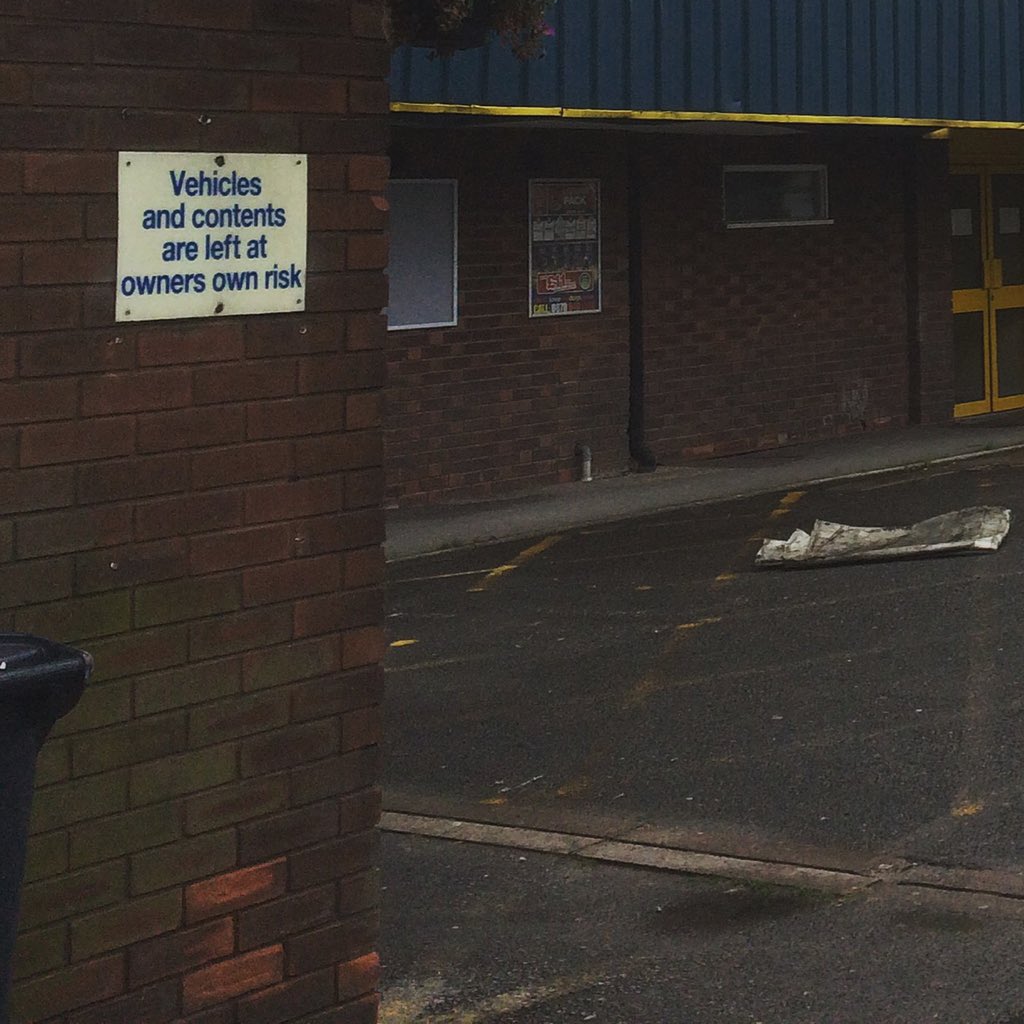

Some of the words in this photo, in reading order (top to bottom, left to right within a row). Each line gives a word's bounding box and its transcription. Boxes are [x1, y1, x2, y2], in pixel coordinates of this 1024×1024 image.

[169, 169, 262, 197] Vehicles
[142, 202, 185, 230] and
[191, 203, 287, 229] contents
[161, 240, 199, 262] are
[204, 234, 242, 261] left
[246, 235, 268, 259] at
[120, 272, 207, 297] owners
[212, 270, 259, 293] own
[264, 263, 303, 290] risk
